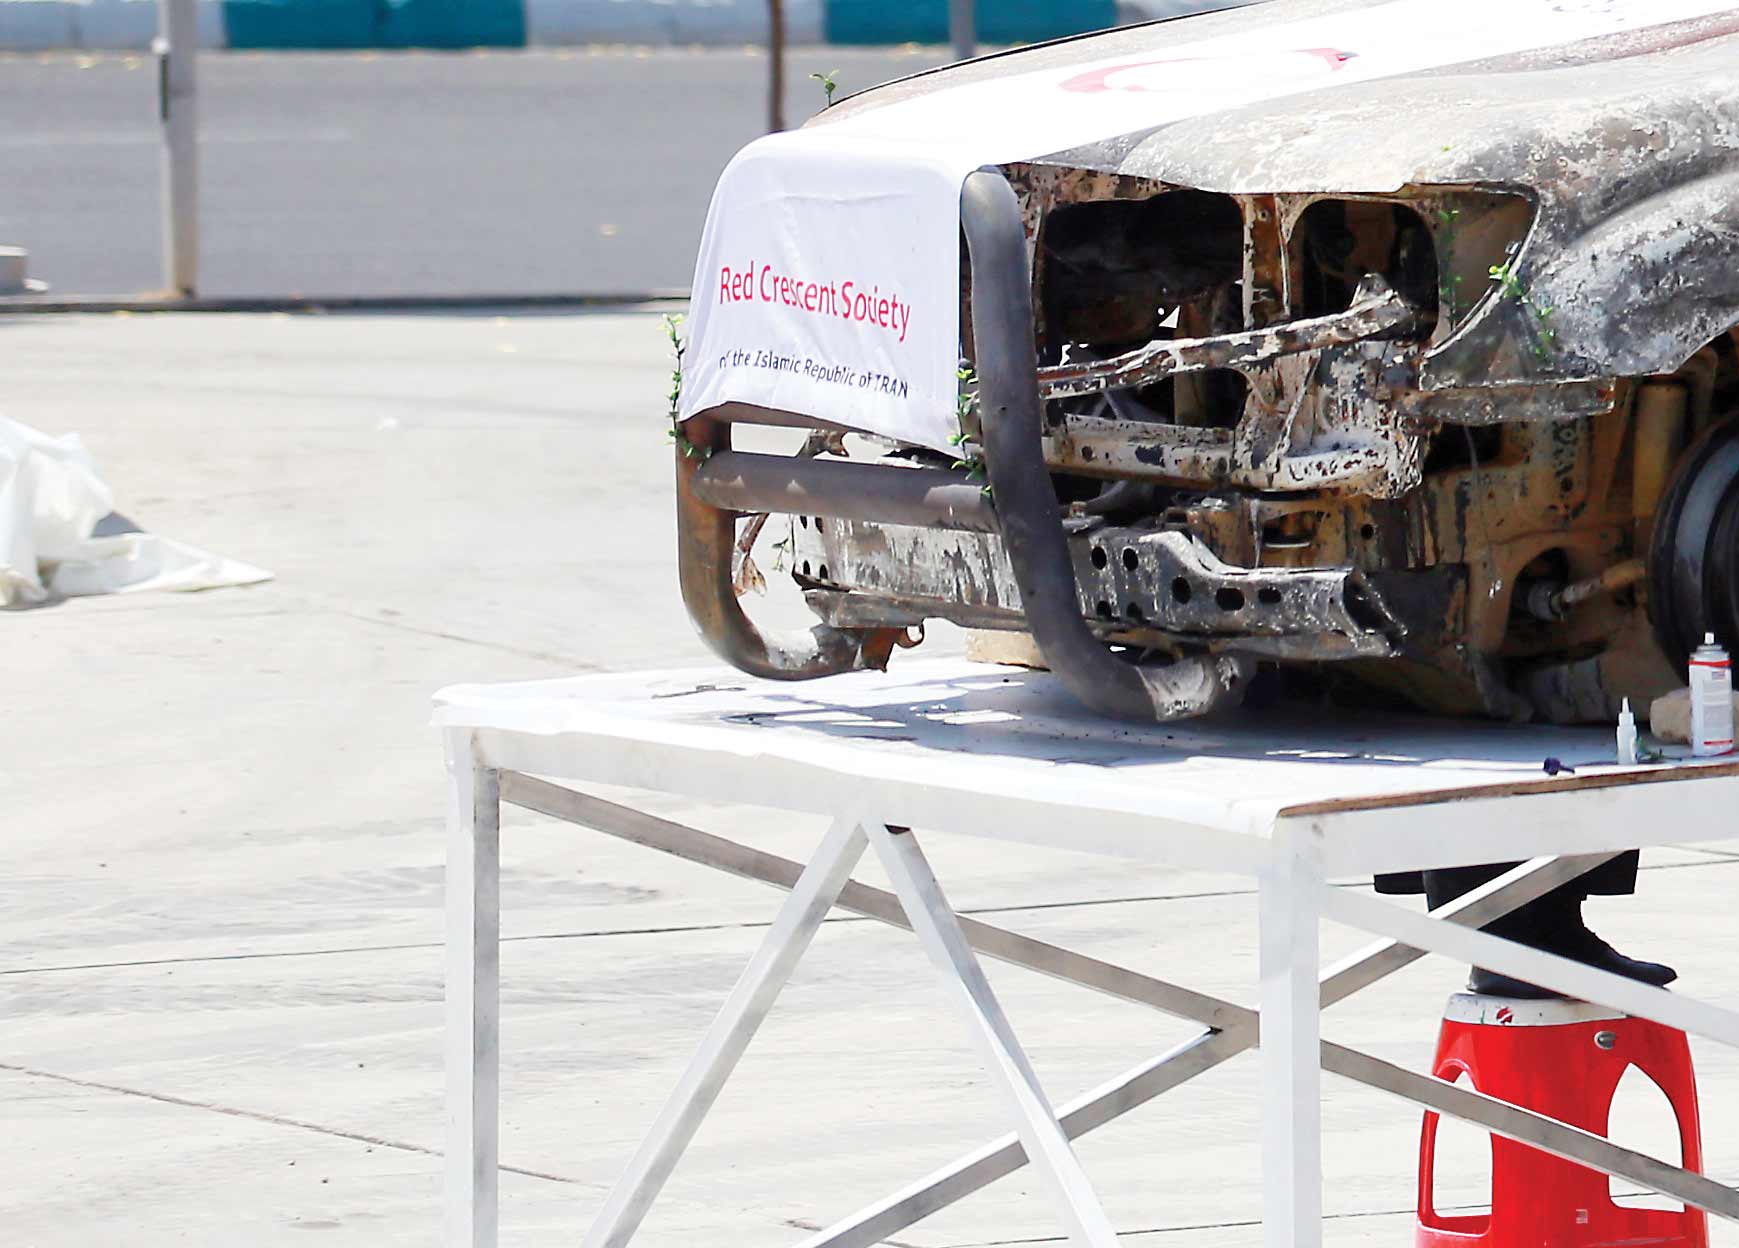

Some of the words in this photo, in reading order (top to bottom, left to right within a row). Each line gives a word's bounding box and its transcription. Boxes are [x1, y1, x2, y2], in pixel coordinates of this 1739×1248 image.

[719, 260, 754, 304] Red
[759, 264, 838, 317] Crescent
[841, 280, 910, 342] Society
[732, 348, 750, 368] the
[753, 350, 801, 373] Islamic
[802, 358, 855, 387] Republic
[859, 371, 873, 388] of
[874, 374, 909, 399] IRAN
